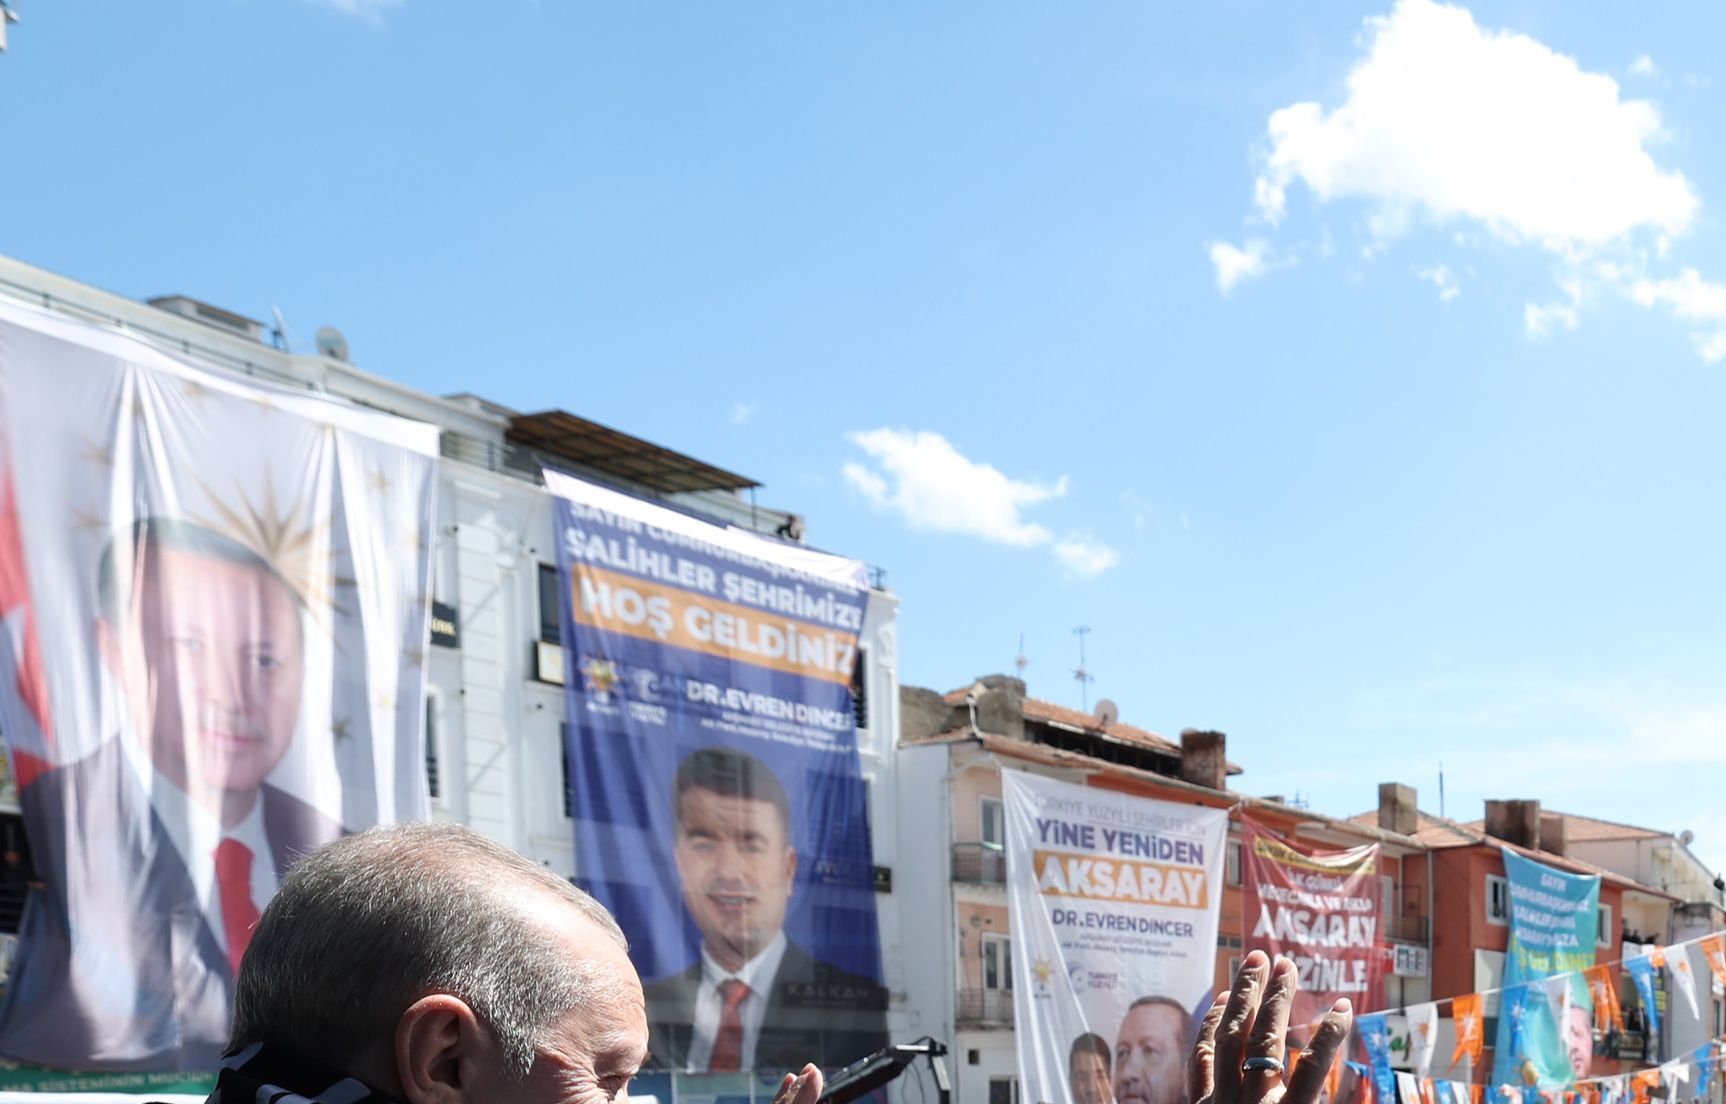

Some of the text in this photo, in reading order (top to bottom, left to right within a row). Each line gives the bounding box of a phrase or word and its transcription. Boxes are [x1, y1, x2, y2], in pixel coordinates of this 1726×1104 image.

[565, 527, 717, 593] SALİHLER
[580, 576, 855, 675] HOŞ GELDİNİZ
[723, 571, 863, 630] ŞEHRİMİZE
[1036, 818, 1204, 866] YİNE YENİDEN
[1039, 855, 1204, 906] AKSARAY
